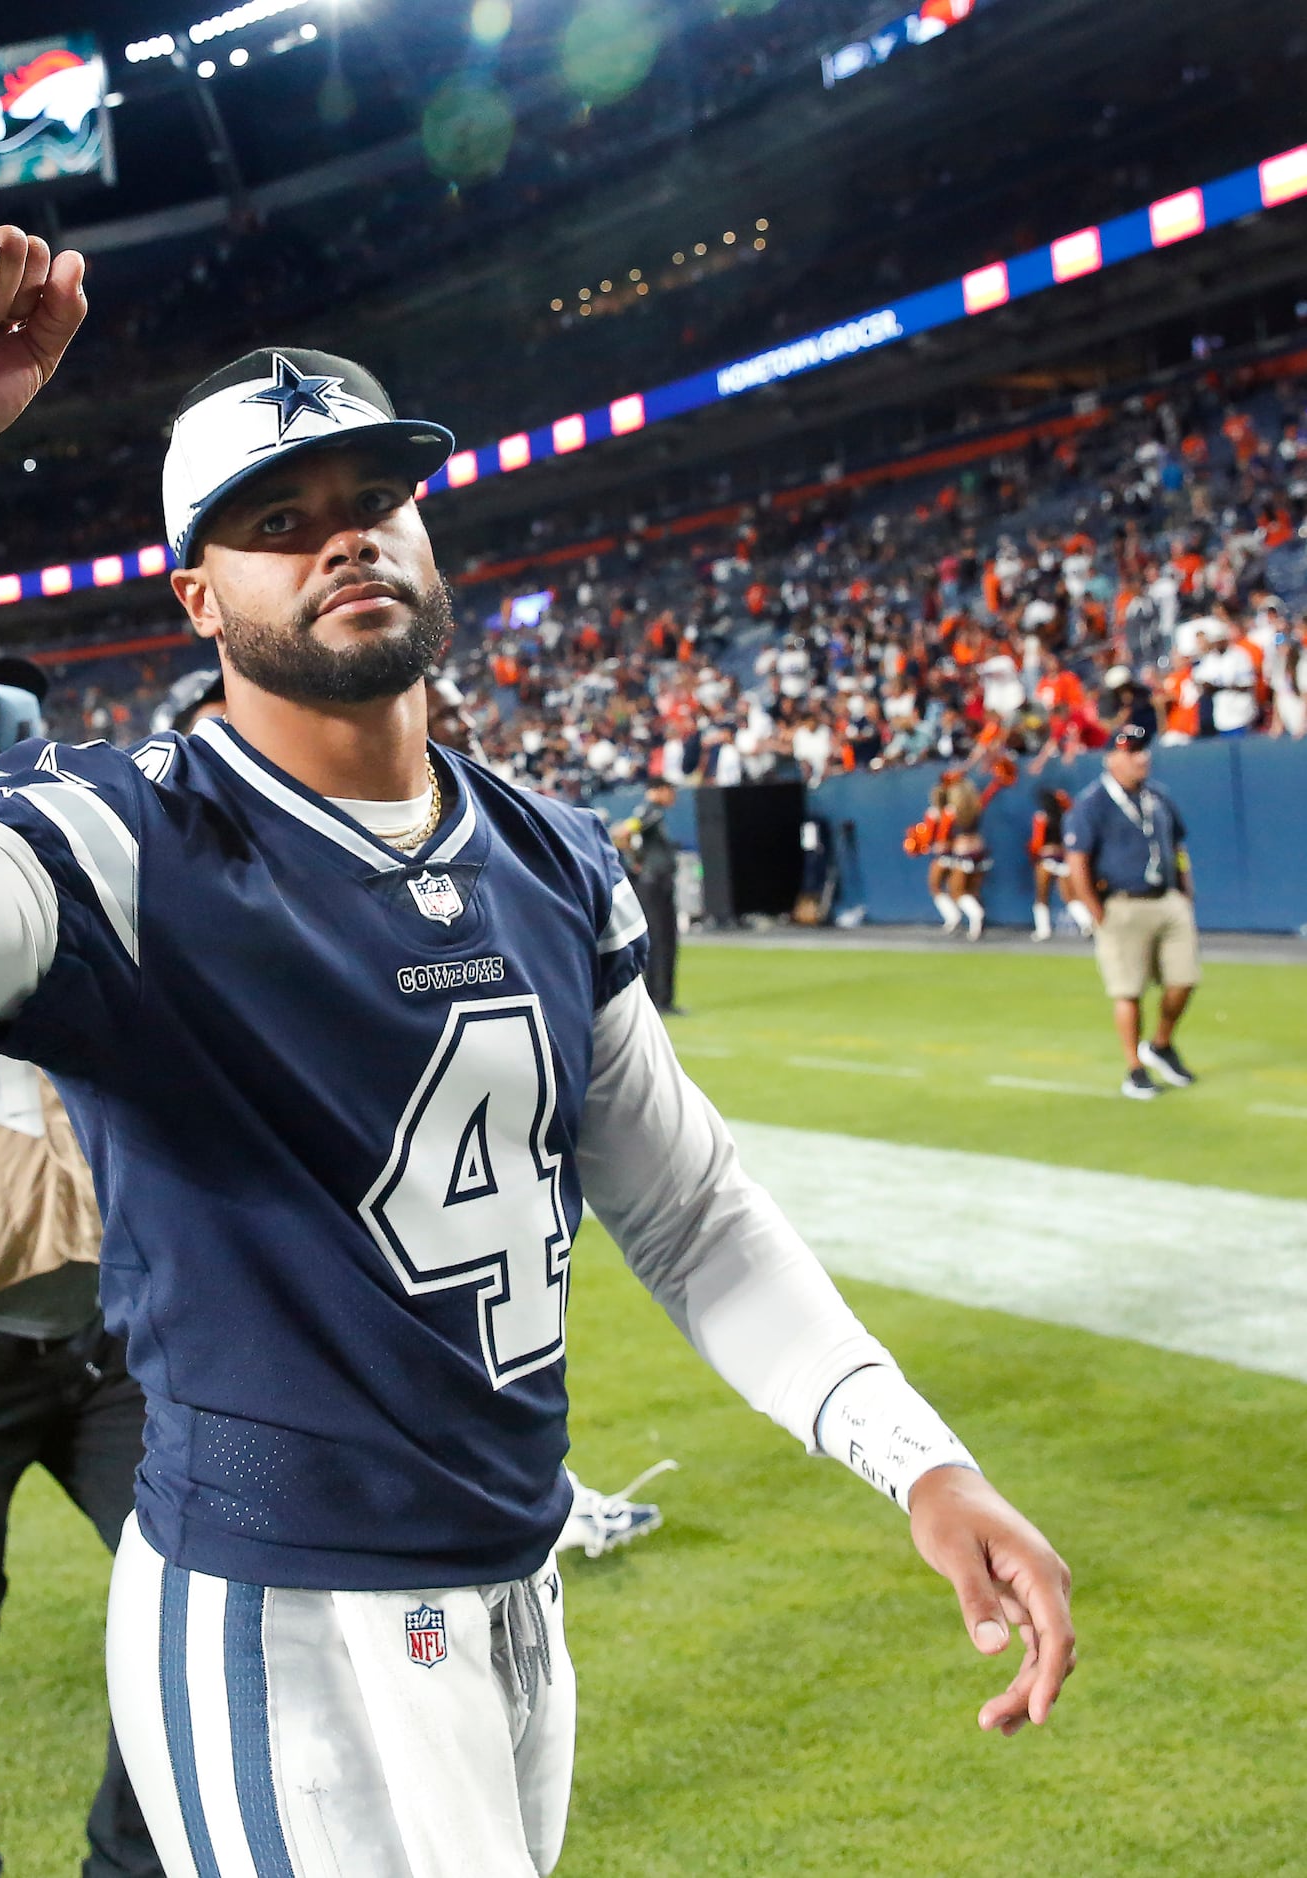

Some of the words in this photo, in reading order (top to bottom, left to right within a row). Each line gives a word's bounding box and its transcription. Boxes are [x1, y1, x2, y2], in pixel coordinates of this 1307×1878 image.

[716, 336, 820, 396] HOMETOWN
[397, 956, 505, 994] COWBOYS
[357, 993, 572, 1392] 4
[409, 1631, 444, 1662] NFL
